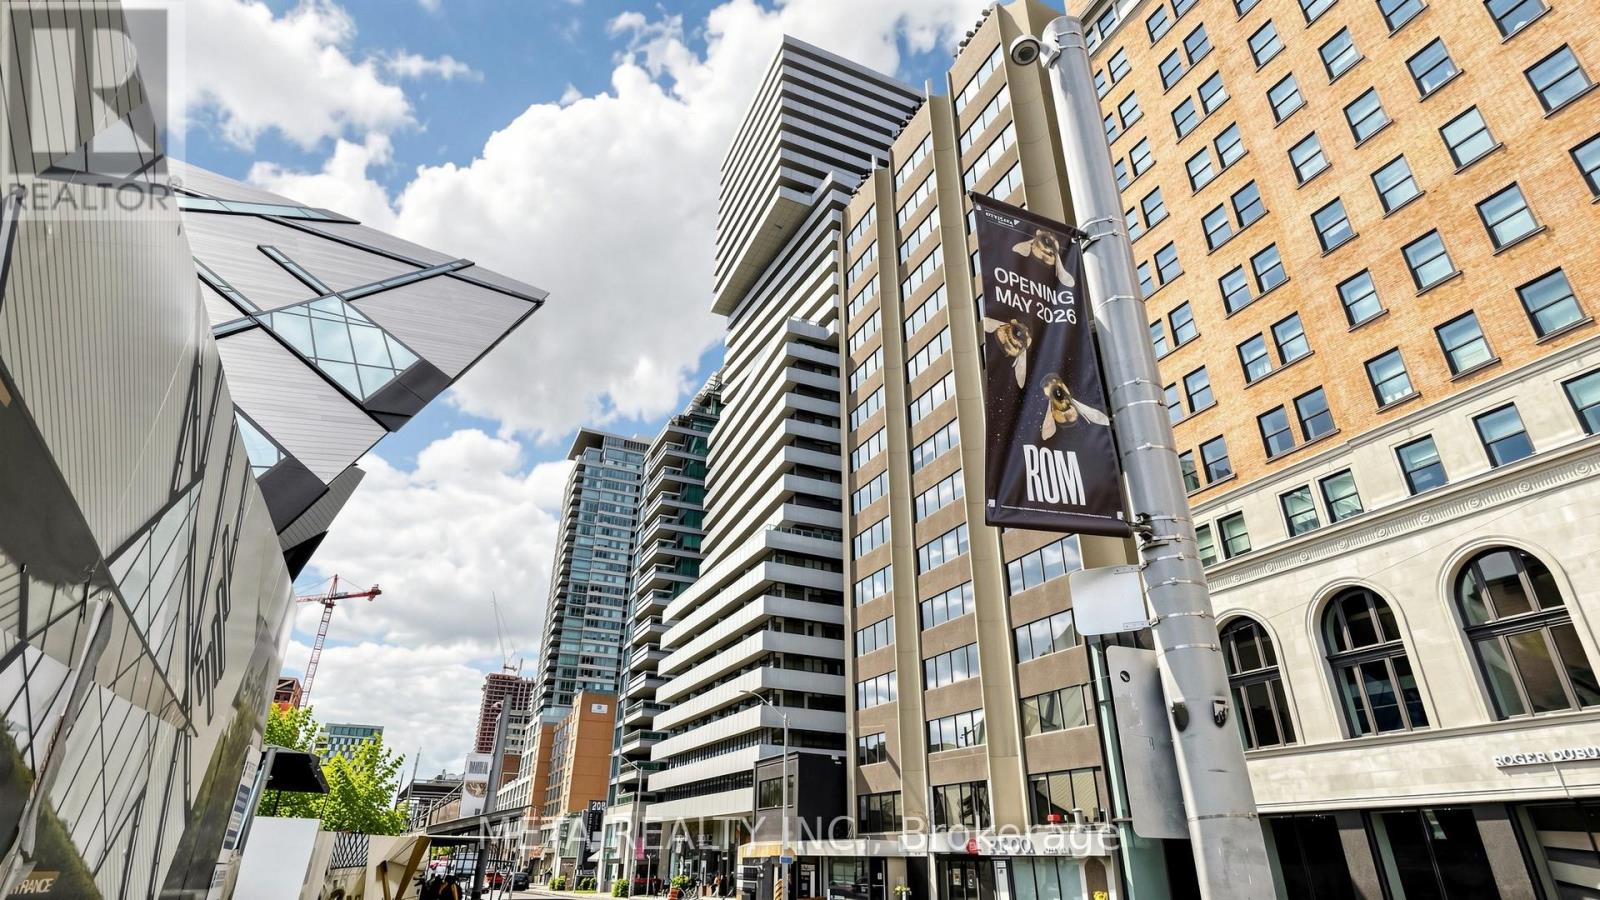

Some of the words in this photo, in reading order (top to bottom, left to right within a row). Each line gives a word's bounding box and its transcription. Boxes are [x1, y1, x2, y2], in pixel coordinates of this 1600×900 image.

[994, 267, 1074, 306] OPENING
[995, 286, 1032, 313] MAY
[1036, 302, 1077, 324] 2026
[1023, 444, 1086, 506] ROM
[1493, 753, 1550, 767] ROGER
[1551, 747, 1600, 763] DUBU
